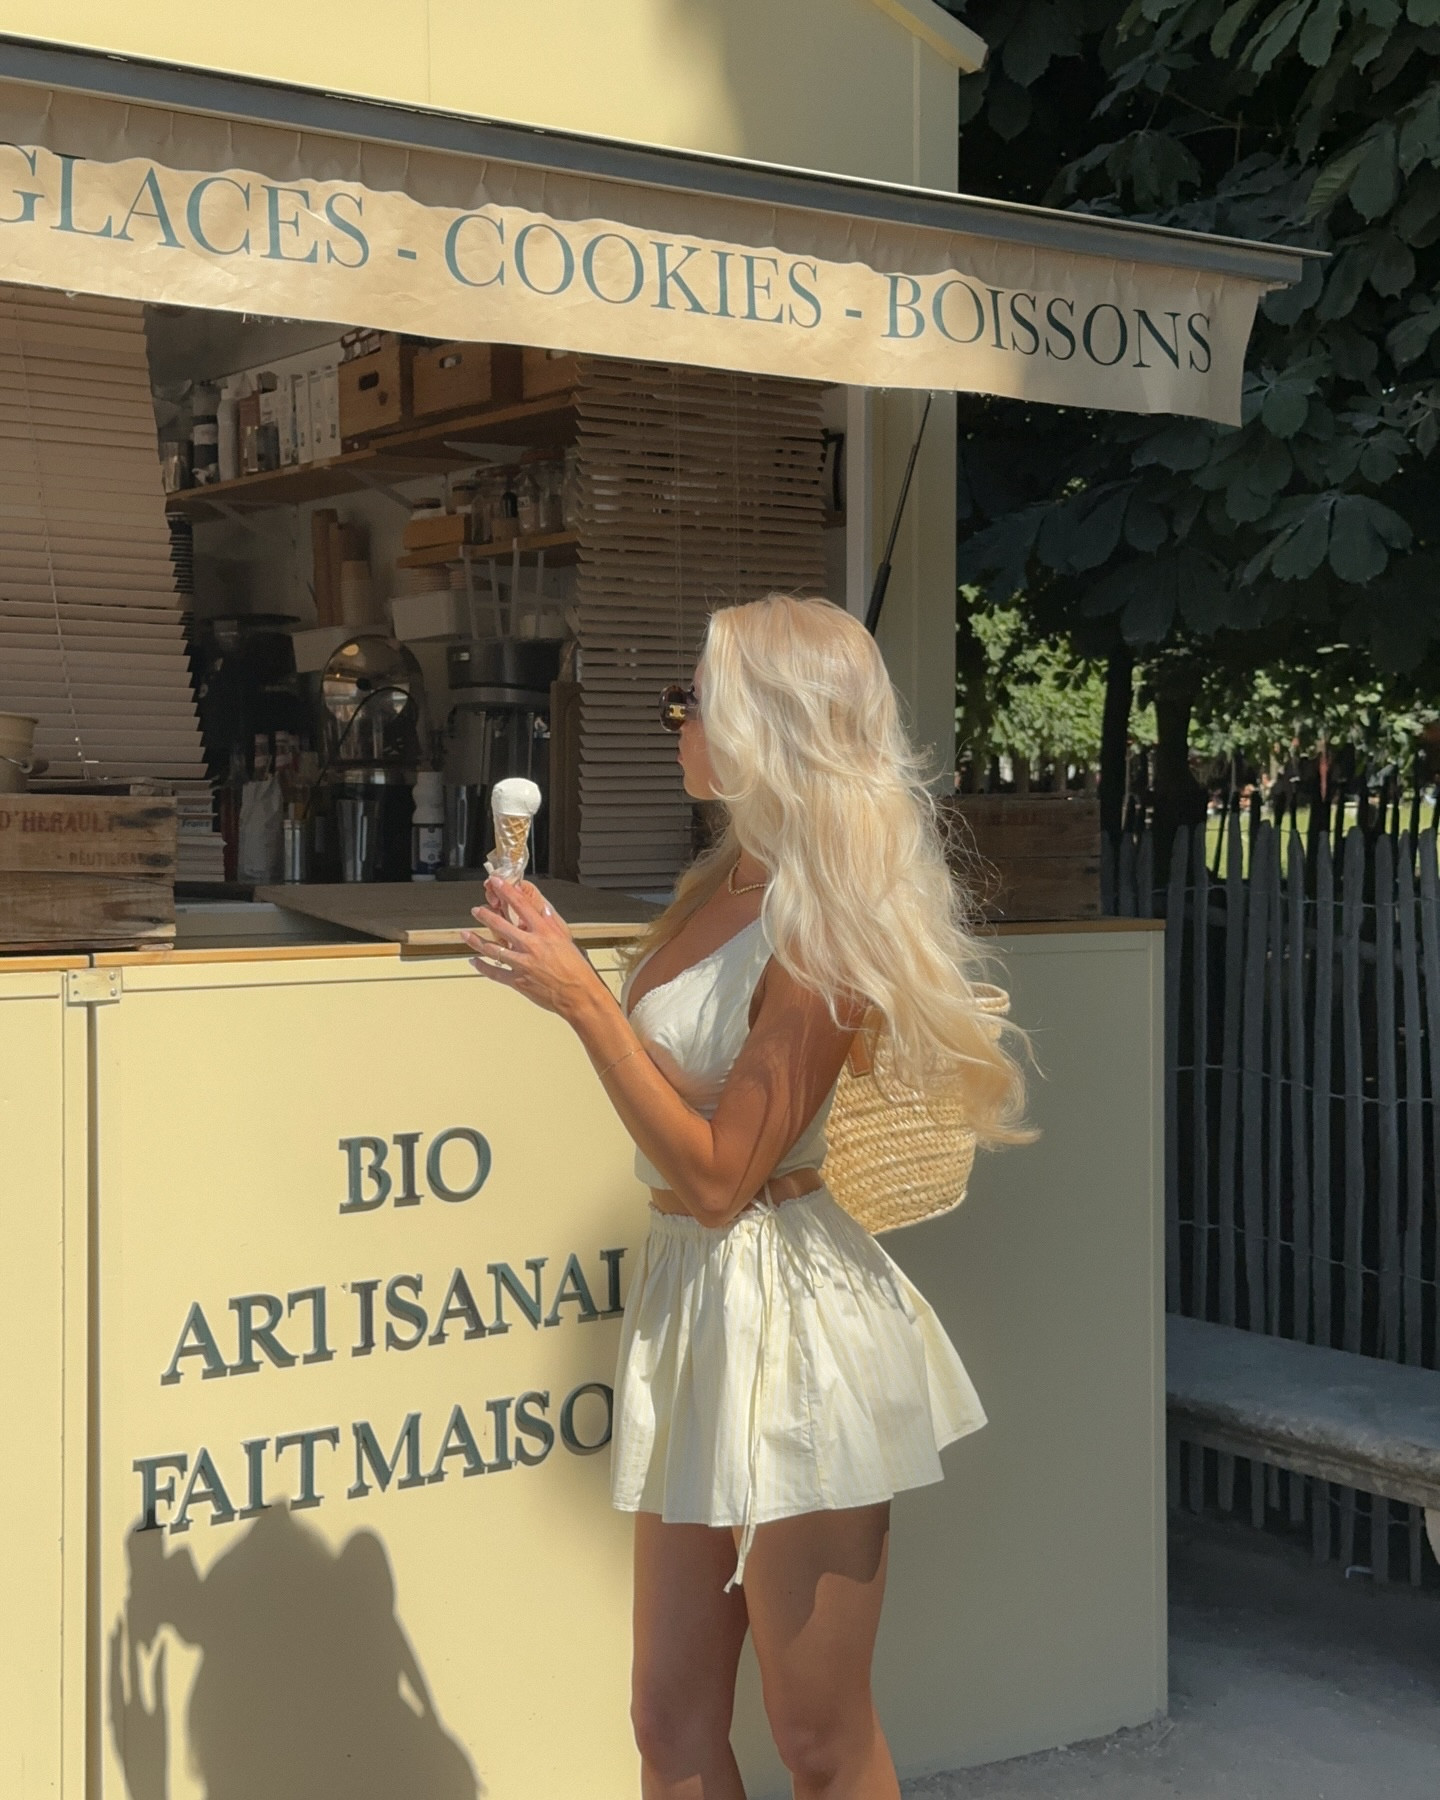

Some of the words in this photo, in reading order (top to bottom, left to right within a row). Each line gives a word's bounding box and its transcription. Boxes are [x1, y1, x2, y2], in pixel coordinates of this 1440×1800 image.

[0, 142, 371, 269] GLACES
[445, 214, 820, 328] COOKIES
[881, 274, 1211, 373] BOISSONS
[338, 1126, 492, 1214] BIO
[132, 1425, 340, 1534] FAIT
[347, 1382, 614, 1500] MAISO
